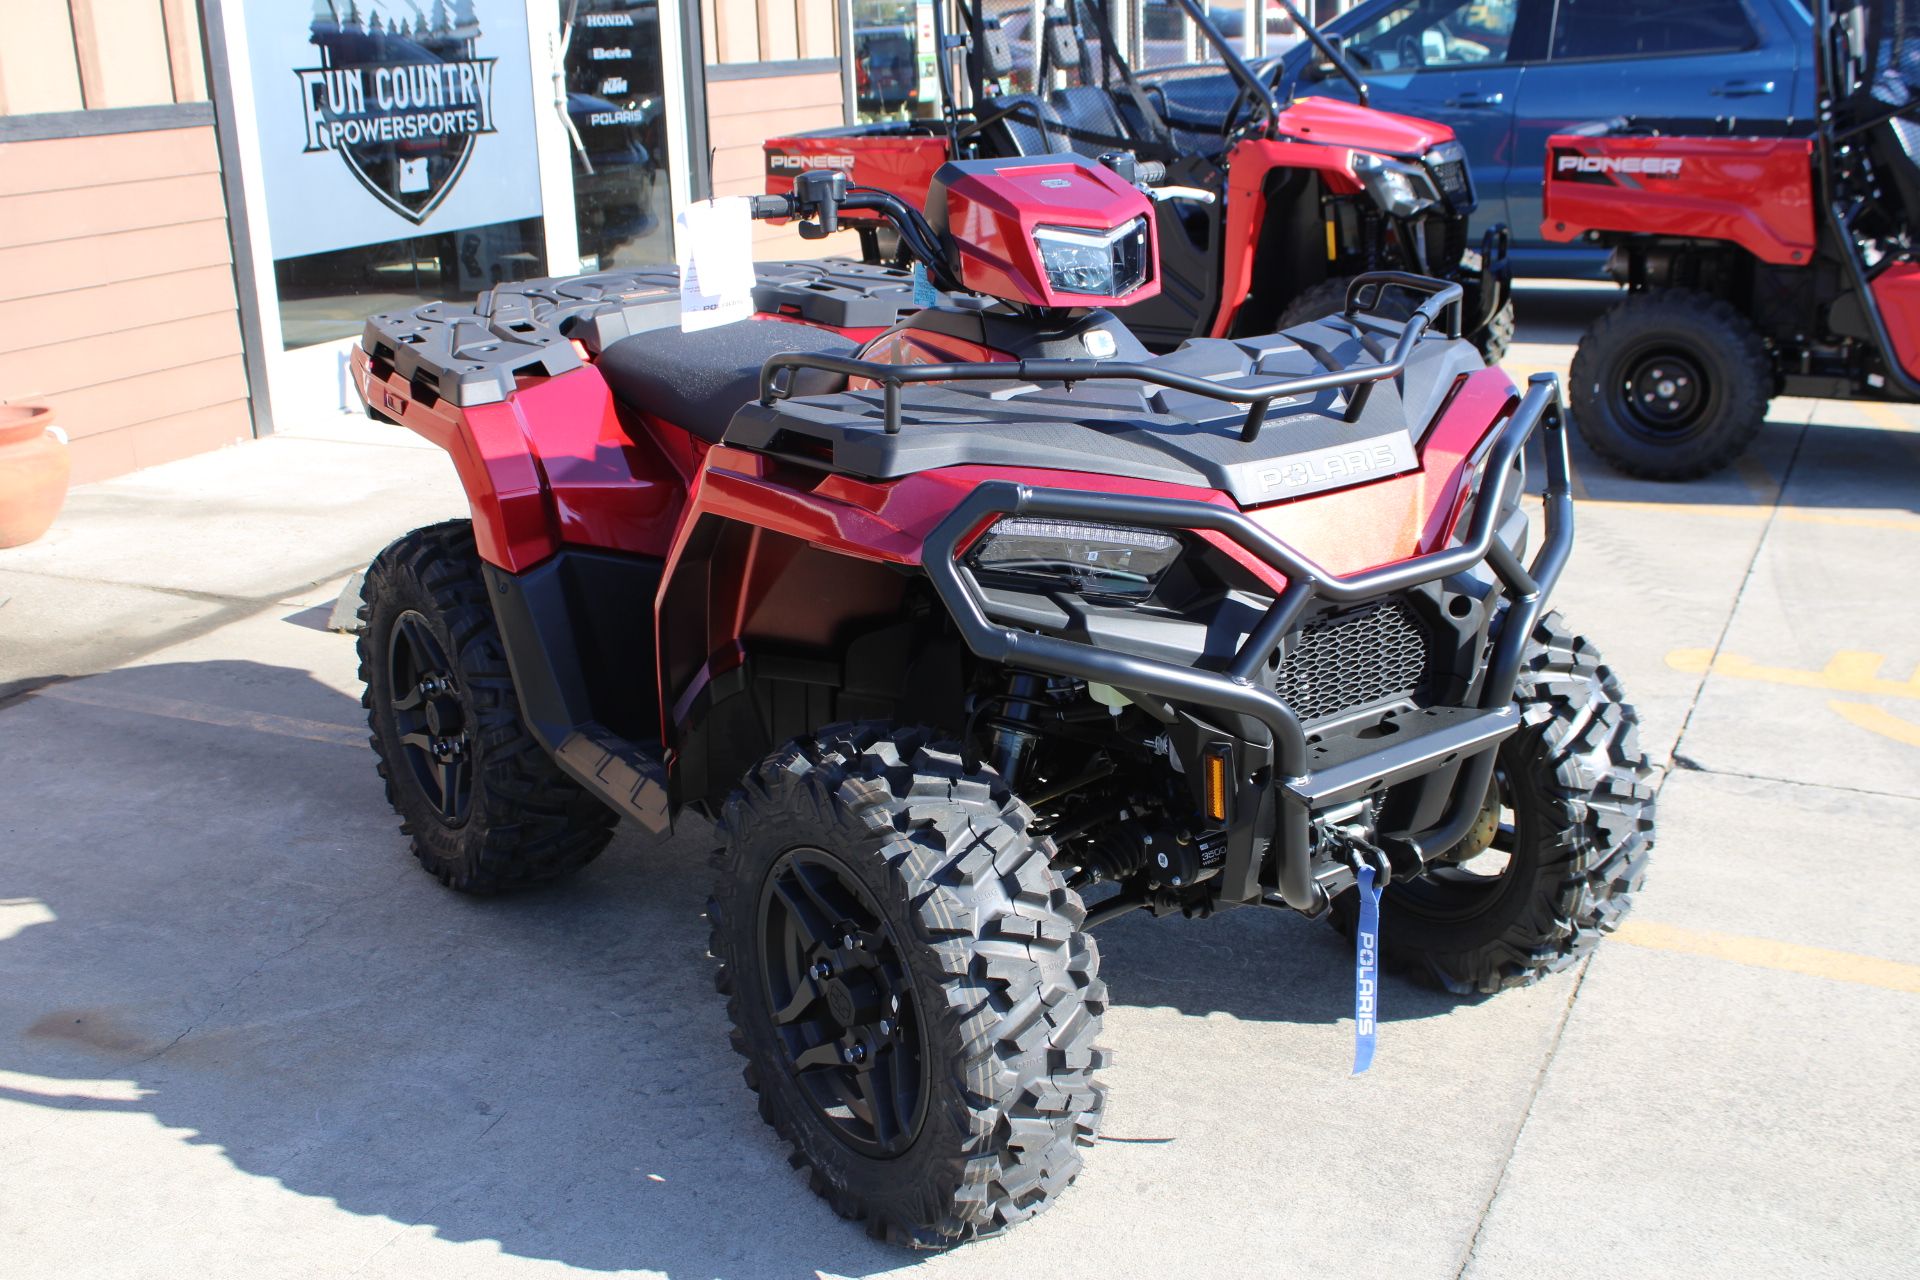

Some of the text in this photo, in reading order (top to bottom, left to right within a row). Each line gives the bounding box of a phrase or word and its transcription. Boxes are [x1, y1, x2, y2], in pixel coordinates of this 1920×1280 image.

[586, 14, 634, 27] HONDA
[593, 47, 632, 60] Beta
[602, 77, 628, 94] KTM
[301, 61, 494, 149] FUN COUNTRY
[591, 110, 643, 126] POLARIS
[331, 110, 478, 145] POWERSPORTS
[771, 154, 855, 169] PIONEER
[1558, 156, 1682, 174] PIONEER
[1257, 444, 1396, 494] POLARIS
[1359, 931, 1374, 1036] POLARIS
